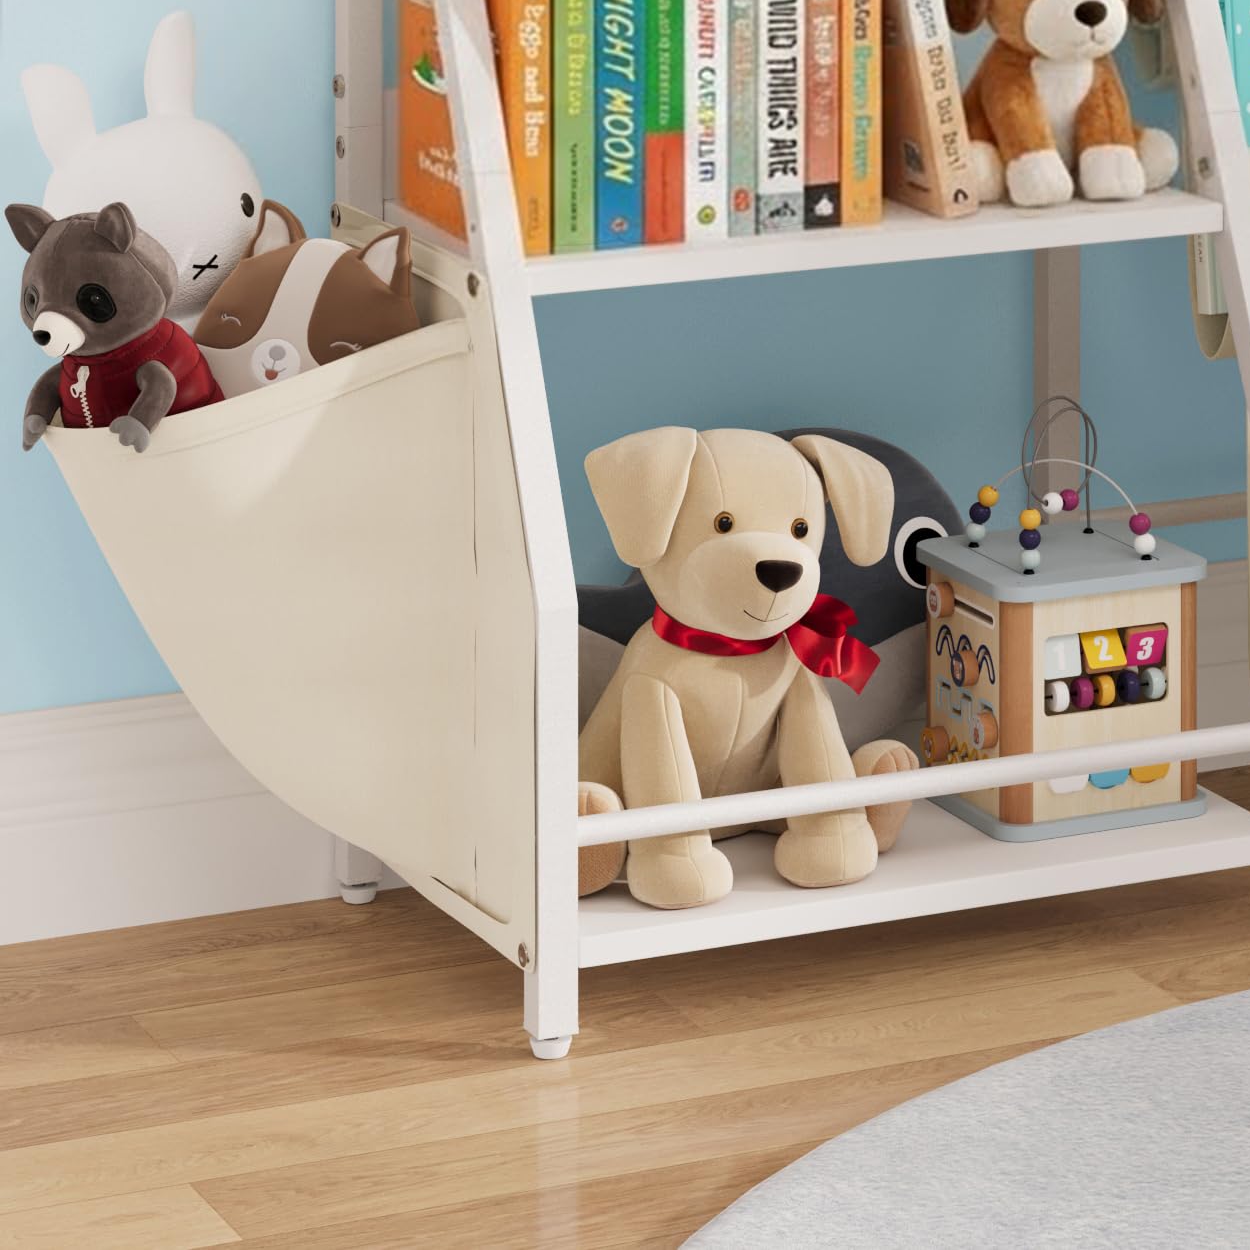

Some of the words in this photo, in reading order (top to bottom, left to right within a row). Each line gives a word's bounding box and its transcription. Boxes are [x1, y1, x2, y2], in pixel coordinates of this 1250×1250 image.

[603, 86, 635, 184] MOON
[1094, 635, 1113, 662] 2
[1137, 636, 1155, 660] 3
